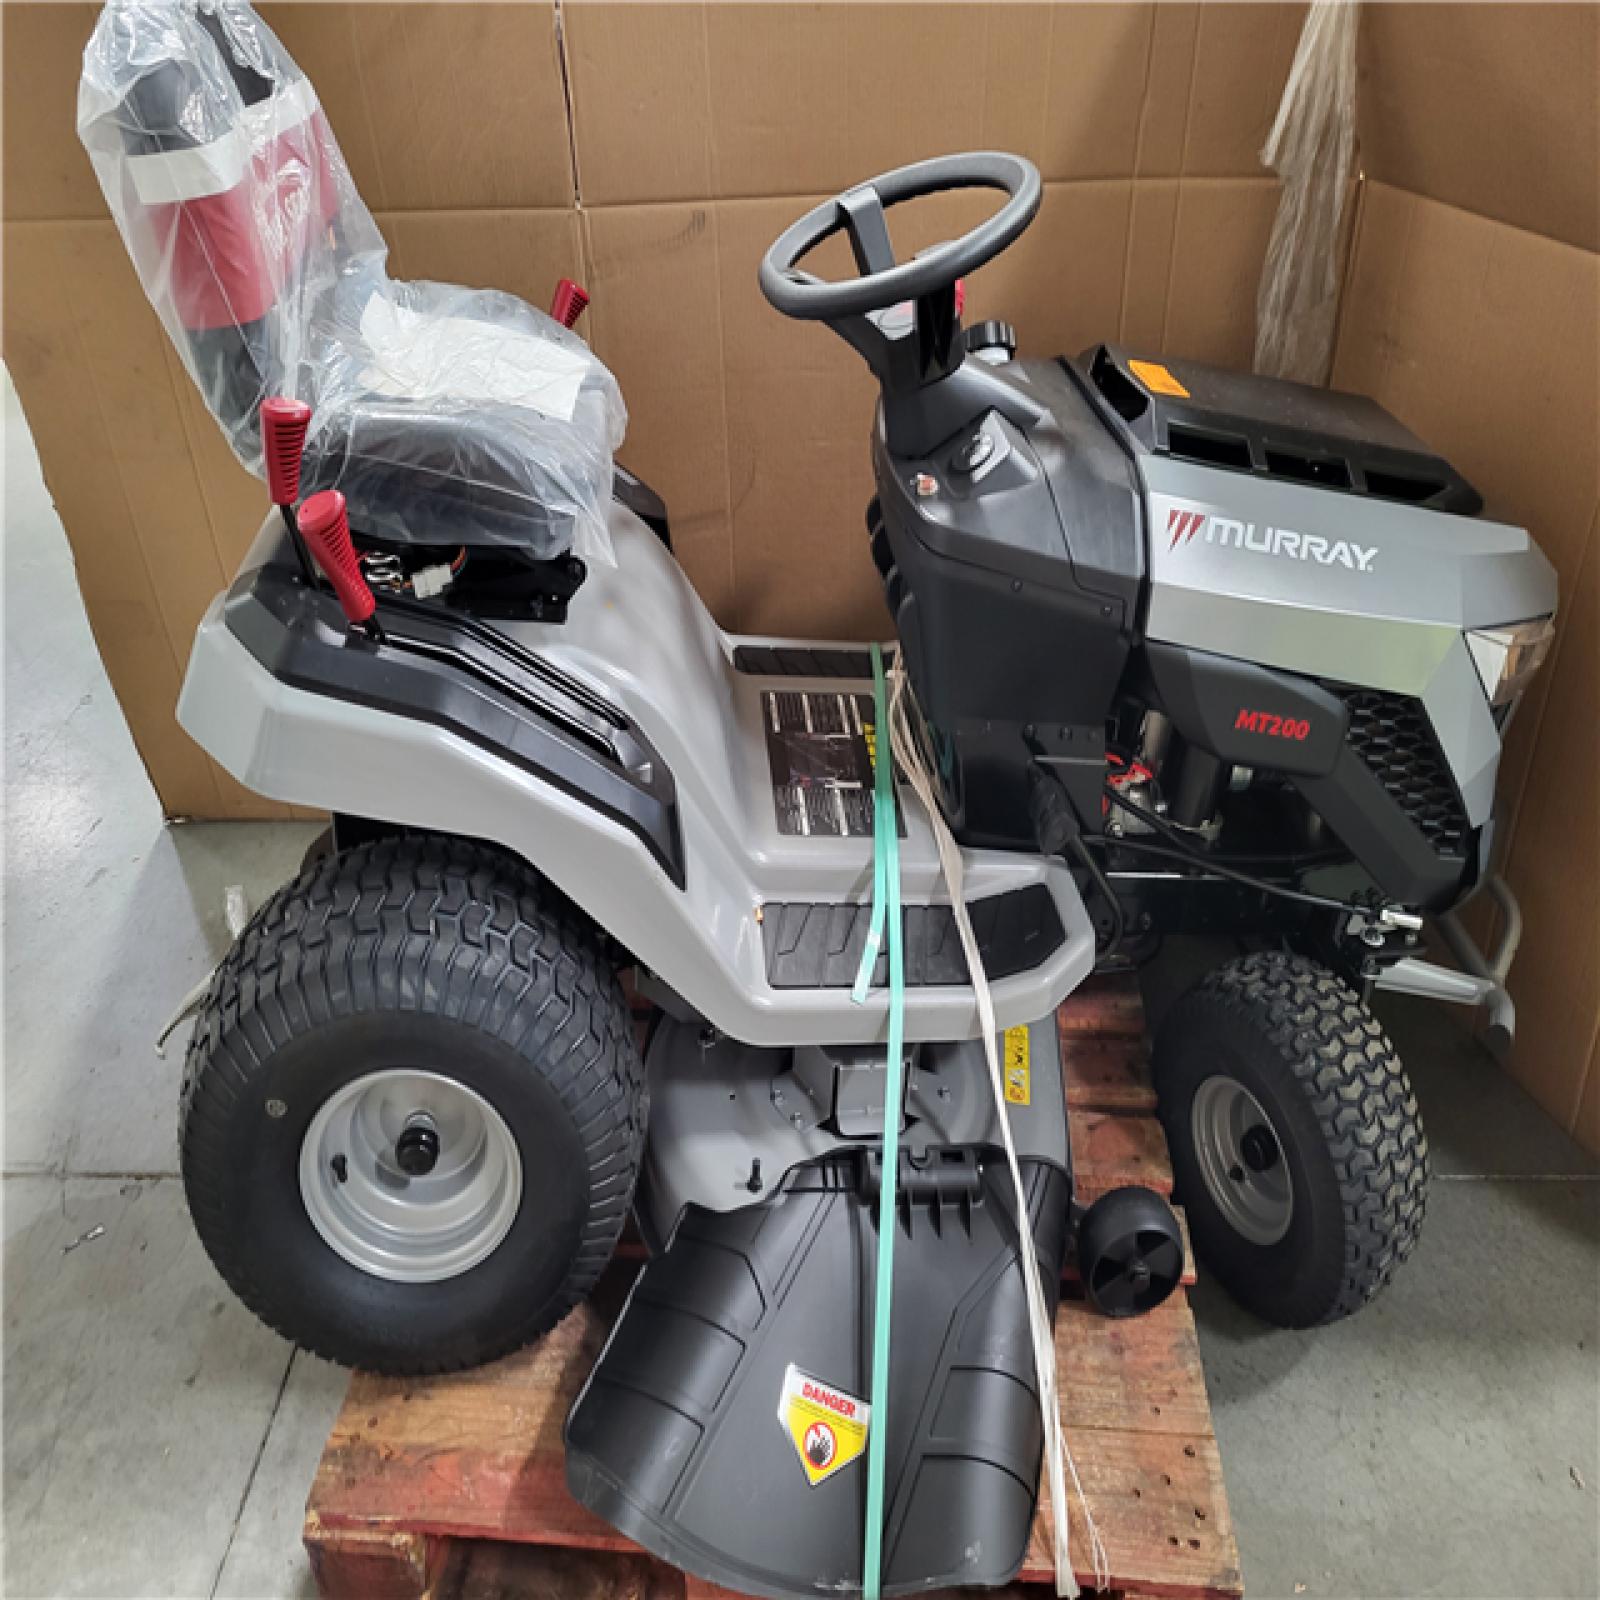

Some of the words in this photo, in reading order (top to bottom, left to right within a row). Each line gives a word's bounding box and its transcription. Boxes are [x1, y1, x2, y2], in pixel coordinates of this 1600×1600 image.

[1205, 516, 1378, 572] MURRAY
[1234, 708, 1310, 741] MT200
[802, 1383, 855, 1417] DANGER
